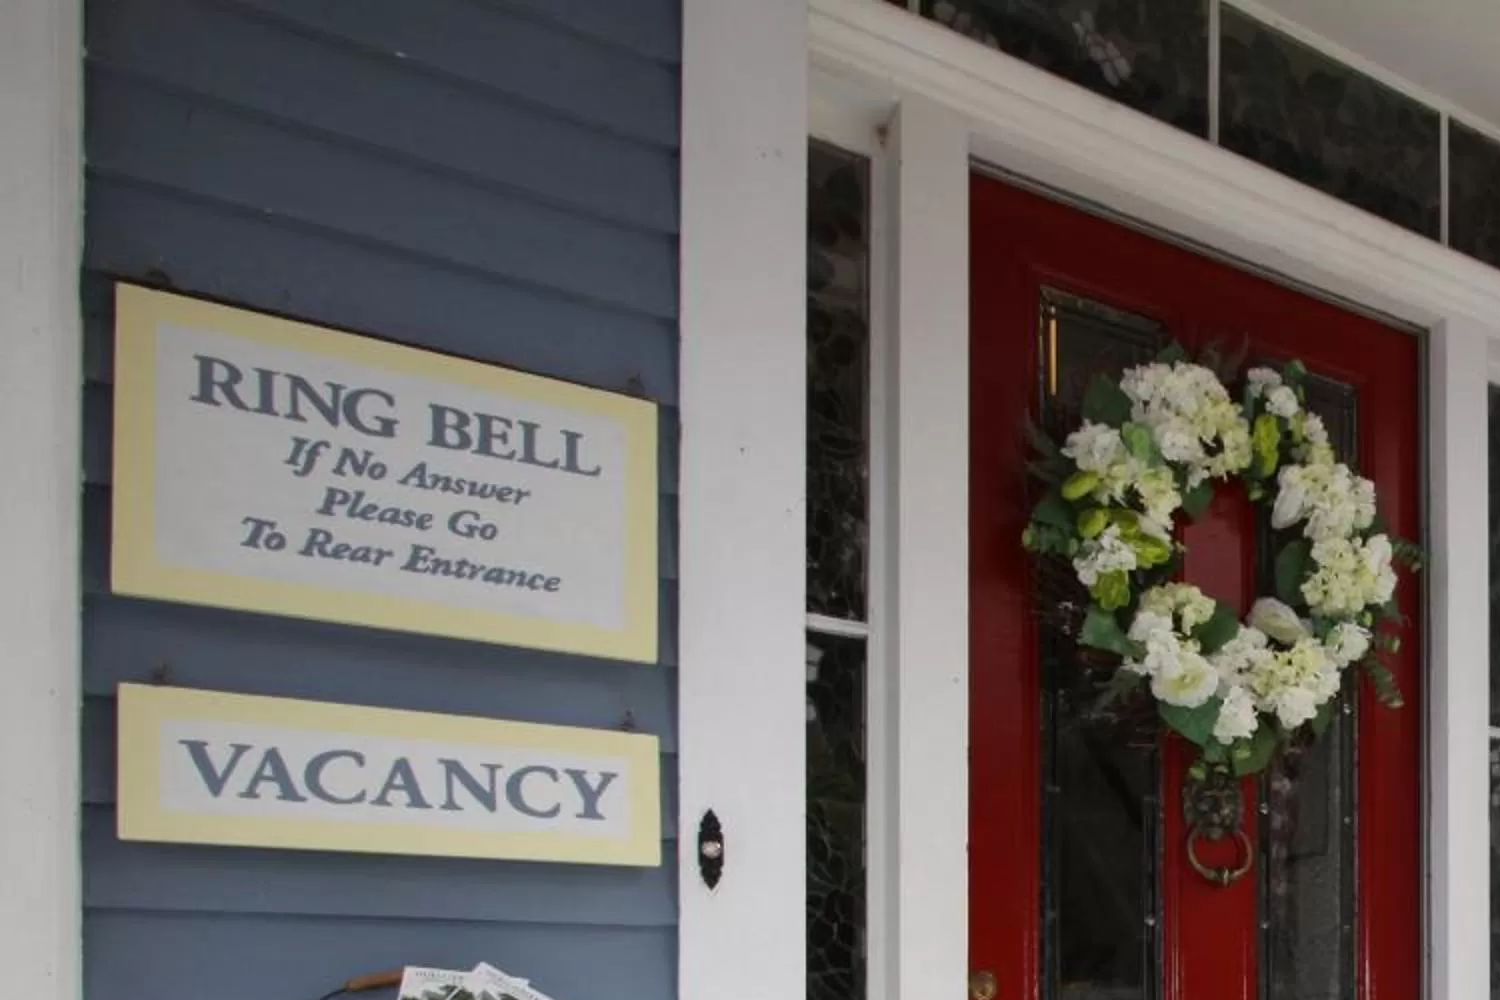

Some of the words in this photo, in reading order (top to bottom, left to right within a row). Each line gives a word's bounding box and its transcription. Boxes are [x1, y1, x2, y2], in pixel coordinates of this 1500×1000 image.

[190, 354, 399, 438] RING
[427, 403, 602, 477] BELL
[284, 437, 327, 477] If
[332, 447, 389, 481] No
[397, 462, 530, 506] Answer
[317, 487, 433, 532] Please
[448, 510, 499, 542] Go
[240, 516, 287, 551] To
[299, 528, 395, 568] Rear
[401, 544, 561, 593] Entrance
[178, 739, 618, 820] VACANCY
